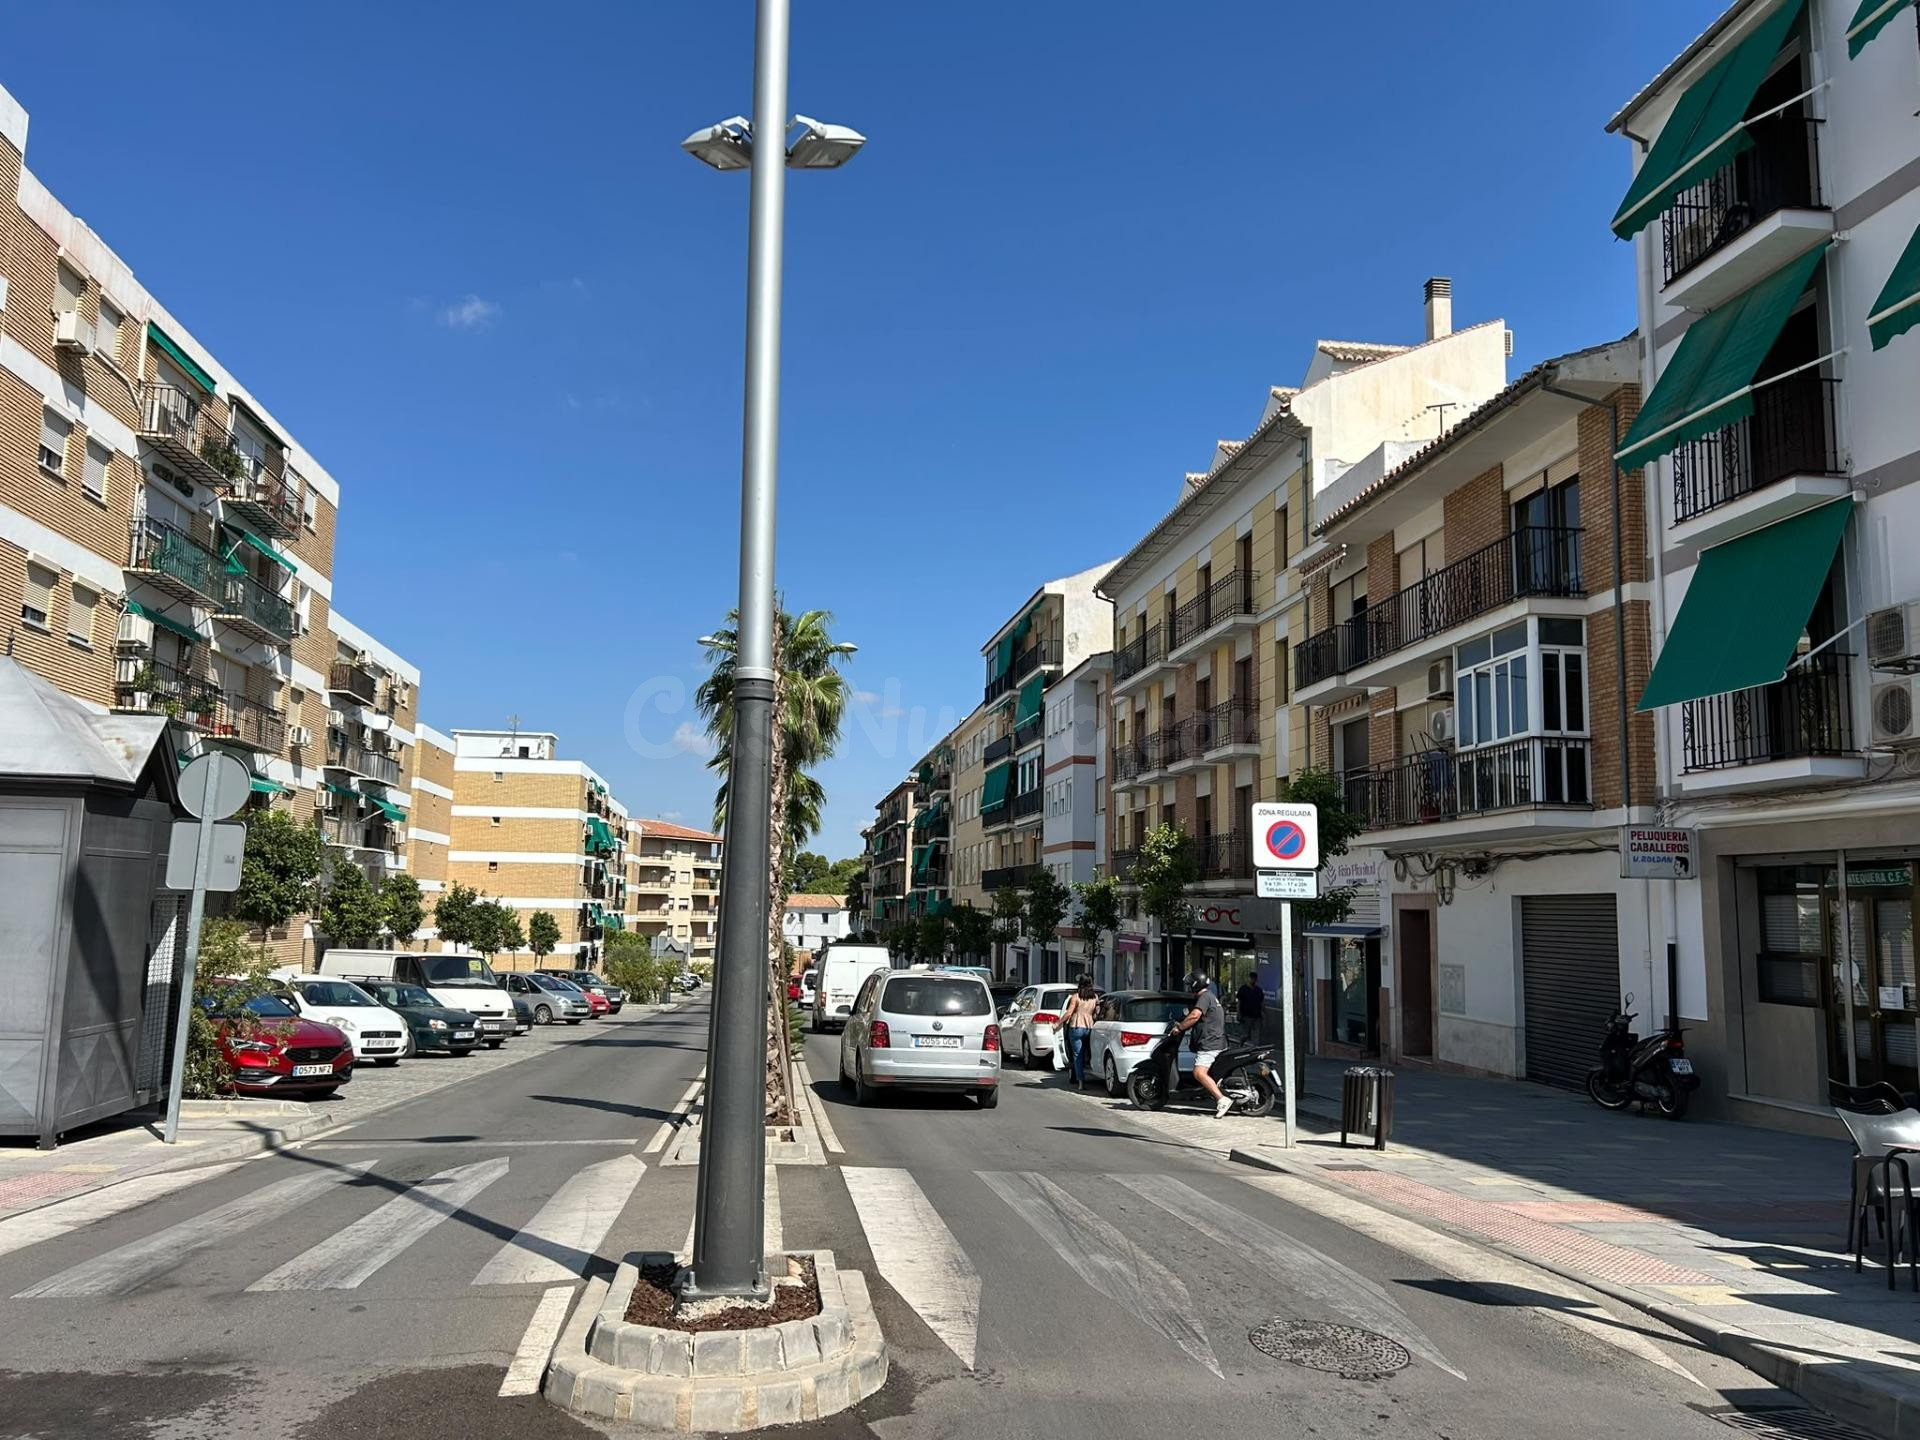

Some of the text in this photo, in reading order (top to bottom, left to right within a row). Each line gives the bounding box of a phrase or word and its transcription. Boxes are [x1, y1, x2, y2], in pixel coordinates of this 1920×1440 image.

[1277, 809, 1311, 817] REGULADA
[1630, 831, 1688, 841] PELUQUERIA
[1630, 843, 1689, 853] CABALLEROS
[299, 1066, 317, 1074] 0573
